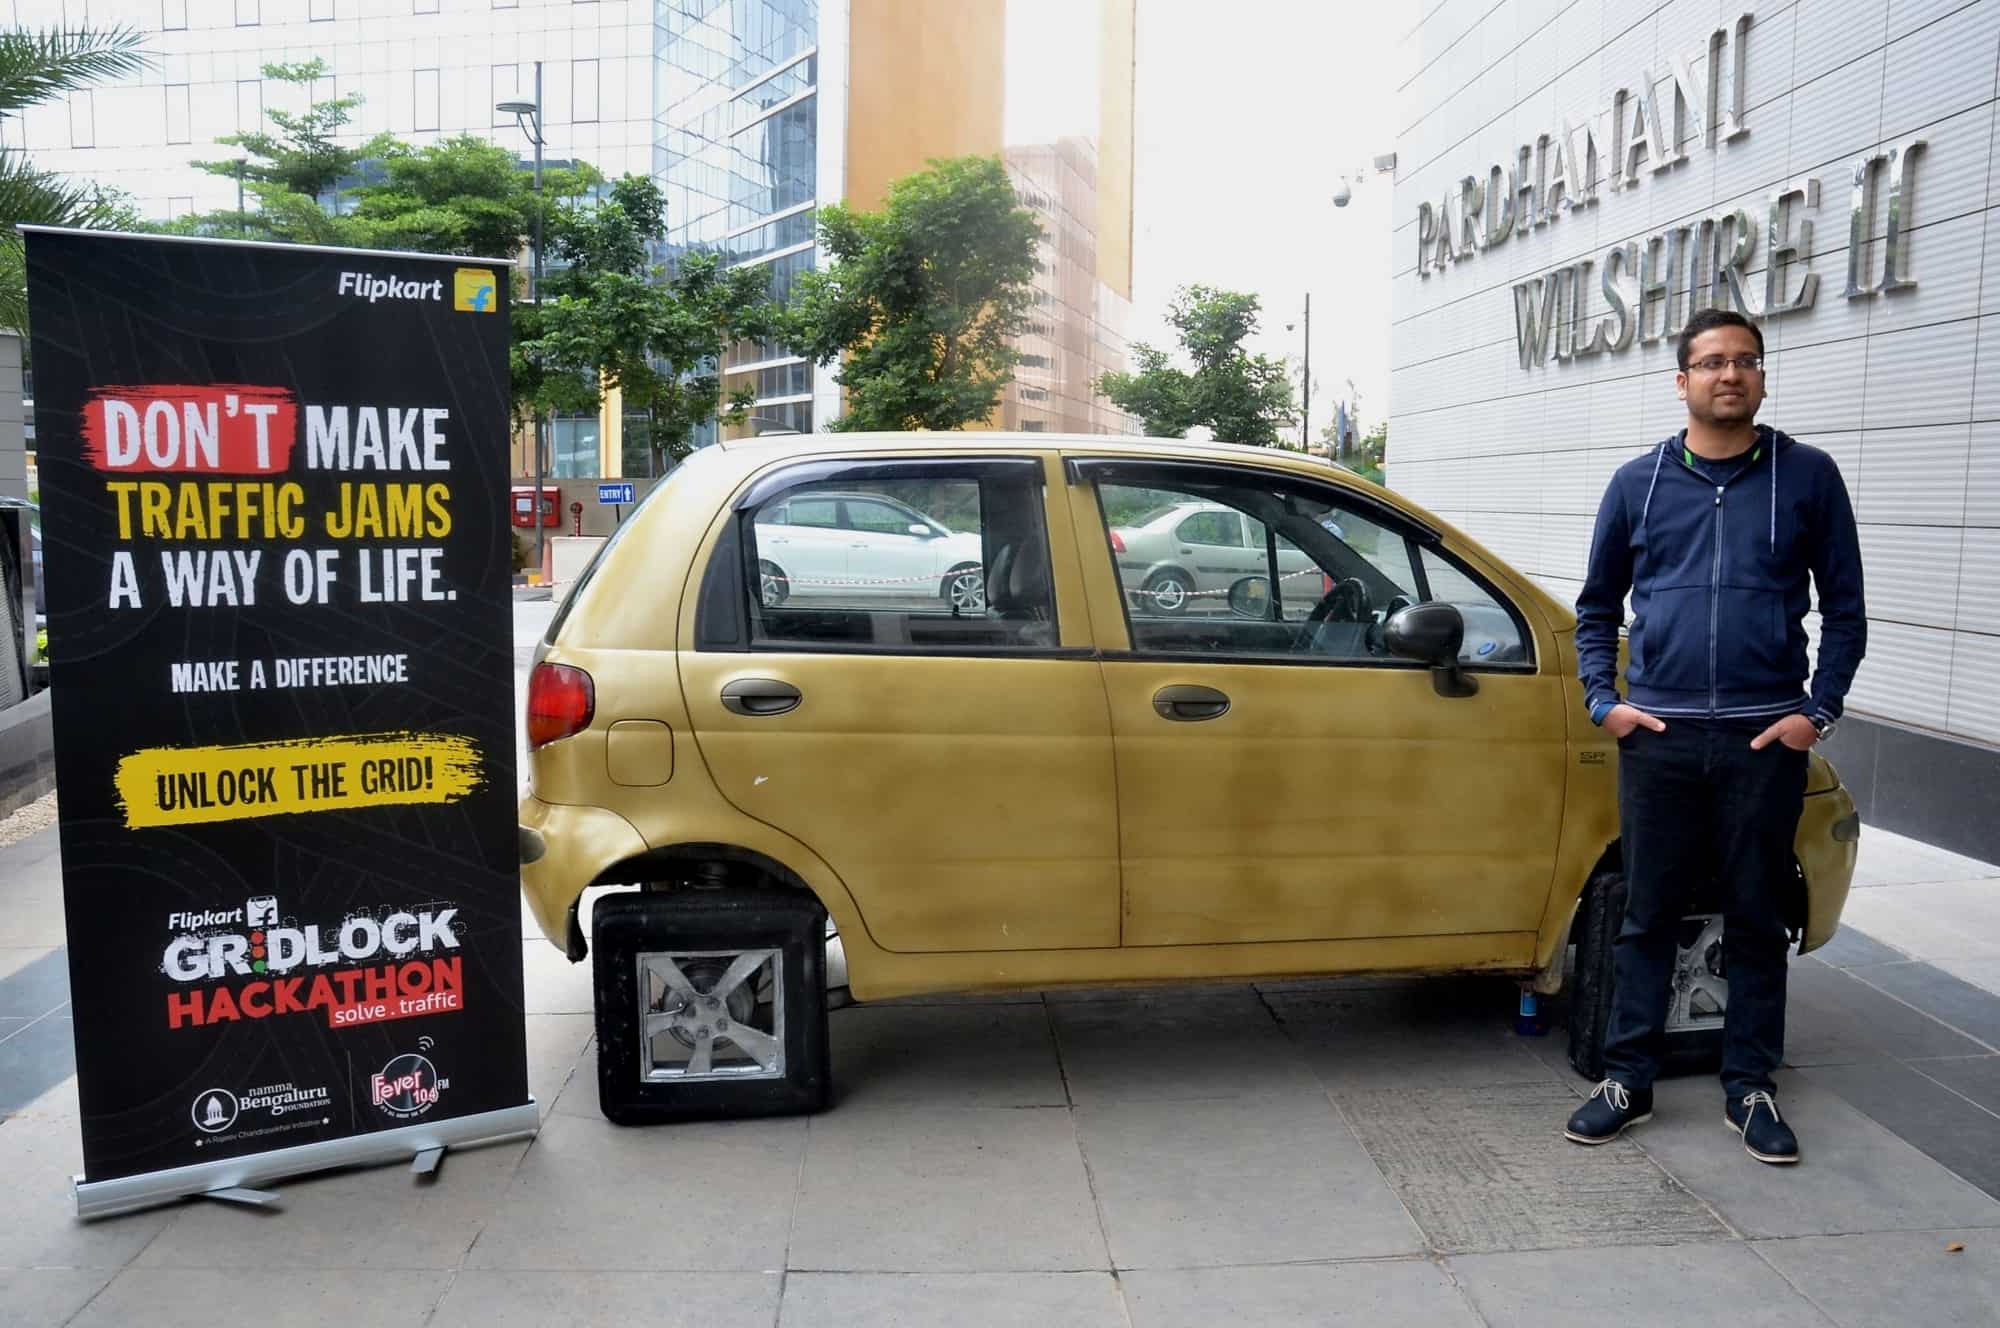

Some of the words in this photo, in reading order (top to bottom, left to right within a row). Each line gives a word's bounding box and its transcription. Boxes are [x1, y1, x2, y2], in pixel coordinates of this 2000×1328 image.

[1417, 12, 1756, 280] PARDHANANI
[1512, 177, 1822, 371] WILSHIRE
[1840, 140, 1929, 301] II
[338, 271, 443, 303] Flipkart
[104, 395, 278, 469] DON'T
[305, 405, 451, 471] MAKE
[107, 481, 305, 540] TRAFFIC
[326, 482, 452, 539] JAMS
[600, 489, 620, 500] ENTRY
[109, 551, 142, 609] A
[162, 549, 262, 607] WAY
[284, 549, 340, 605] OF
[359, 547, 457, 603] LIFE.
[171, 661, 241, 693] MAKE
[250, 659, 267, 689] A
[275, 654, 409, 688] DIFFERENCE
[157, 767, 278, 811] UNLOCK
[290, 762, 348, 801] THE
[361, 756, 433, 795] GRID!
[168, 907, 243, 932] Flipkart
[167, 956, 463, 1029] HACKATHON
[335, 1001, 386, 1024] solve
[400, 992, 457, 1015] traffic
[249, 1082, 293, 1097] namma
[372, 1071, 422, 1105] Fever
[413, 1087, 437, 1104] 104
[437, 1079, 449, 1090] FM
[240, 1087, 328, 1116] Bengaluru
[284, 1099, 331, 1113] FOUNDATION
